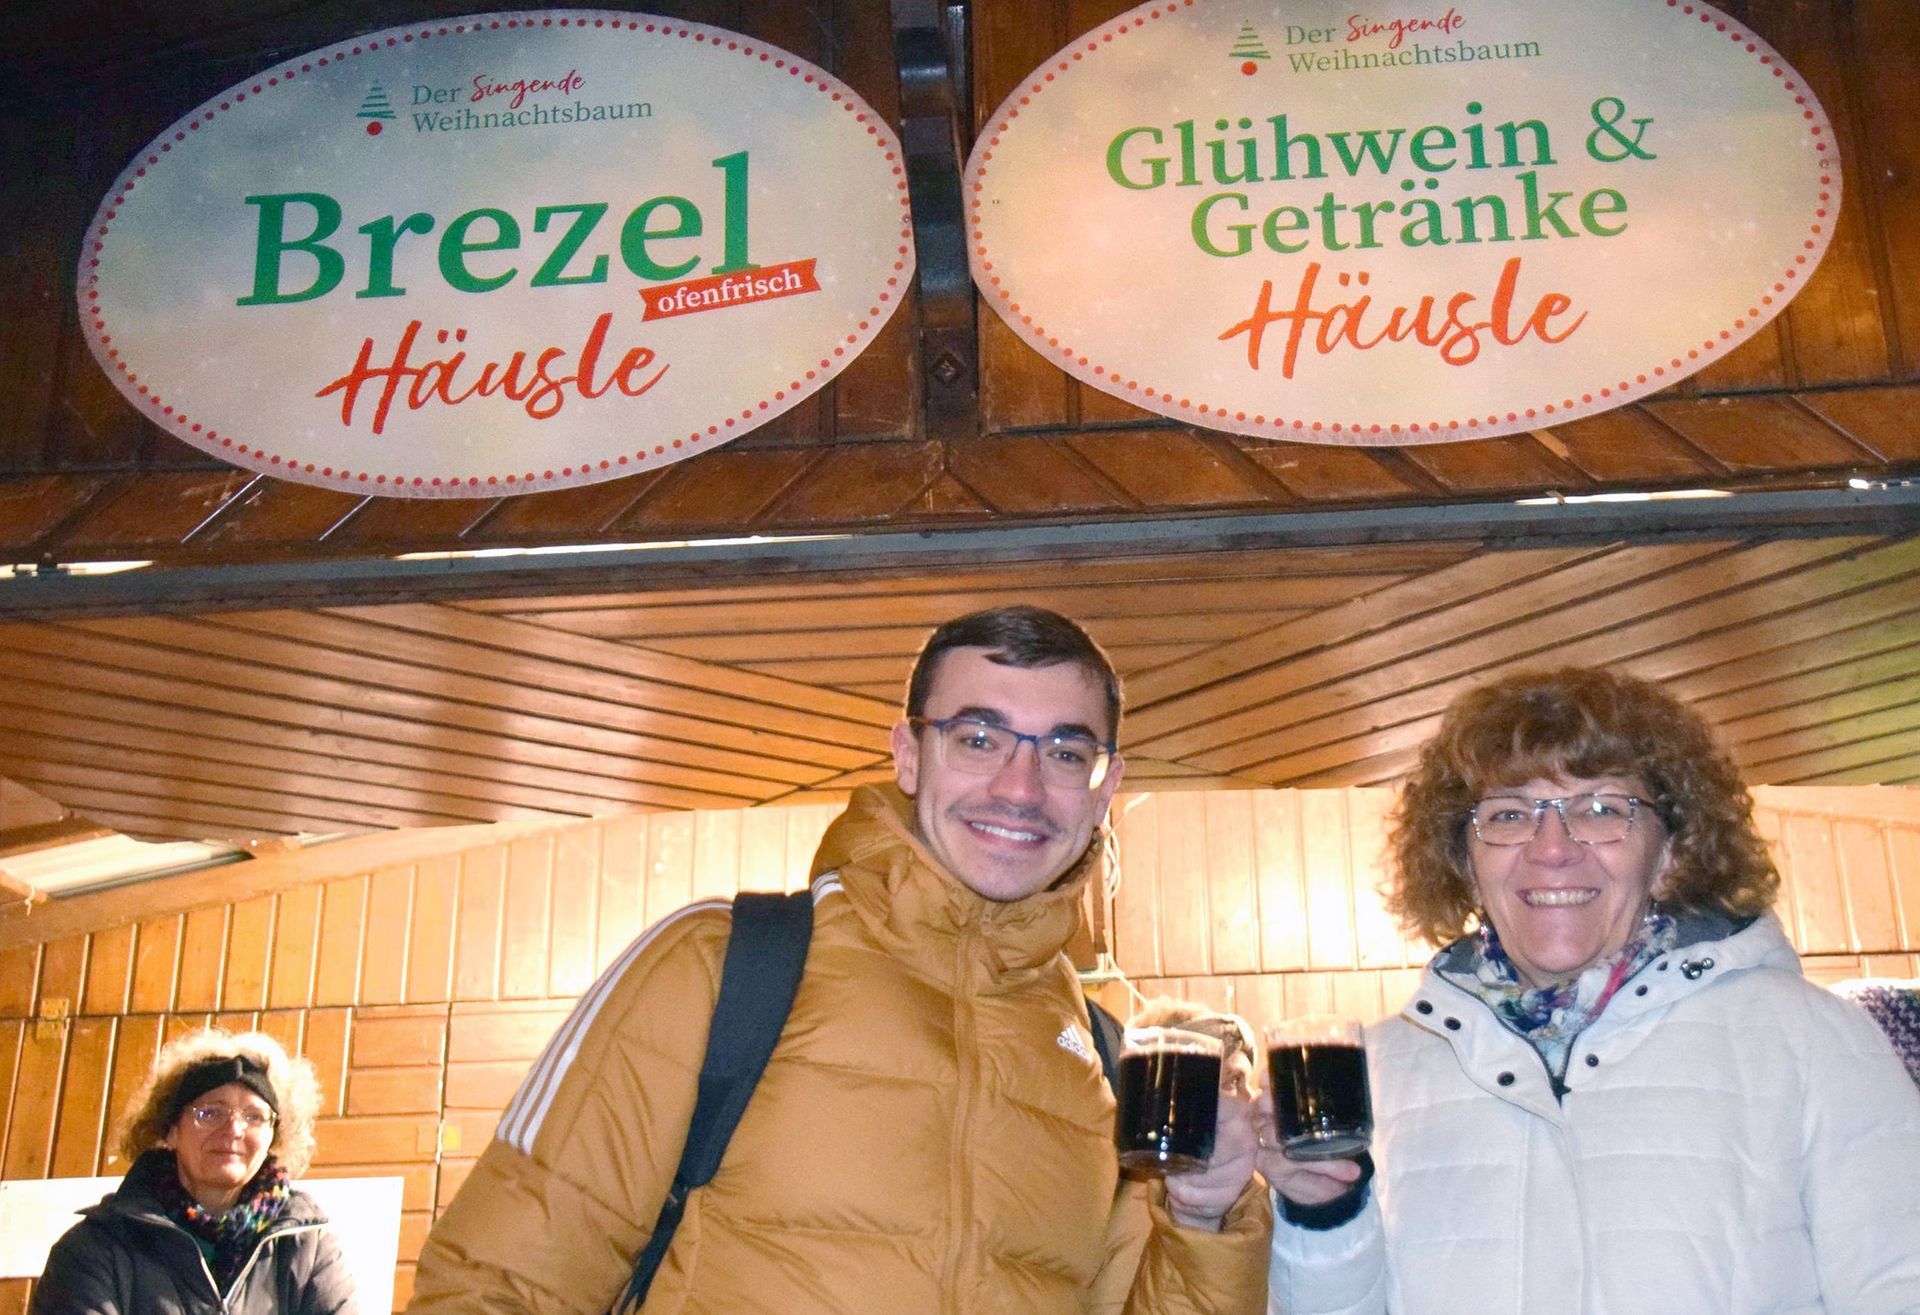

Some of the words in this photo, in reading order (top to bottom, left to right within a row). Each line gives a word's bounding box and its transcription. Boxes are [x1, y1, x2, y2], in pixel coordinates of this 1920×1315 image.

[1285, 24, 1335, 45] Der
[1346, 8, 1466, 49] Singende
[1288, 40, 1542, 73] Weihnachtsbaum
[412, 84, 461, 105] Der
[470, 69, 586, 109] Singende
[412, 101, 652, 133] Weihnachtsbaum
[1105, 101, 1557, 190] Glühwein
[1585, 97, 1658, 162] &
[236, 151, 760, 306] Brezel
[1191, 171, 1629, 257] Getränke
[657, 268, 803, 313] ofenfrisch
[1217, 257, 1588, 380] Häusle
[316, 312, 670, 435] Häusle
